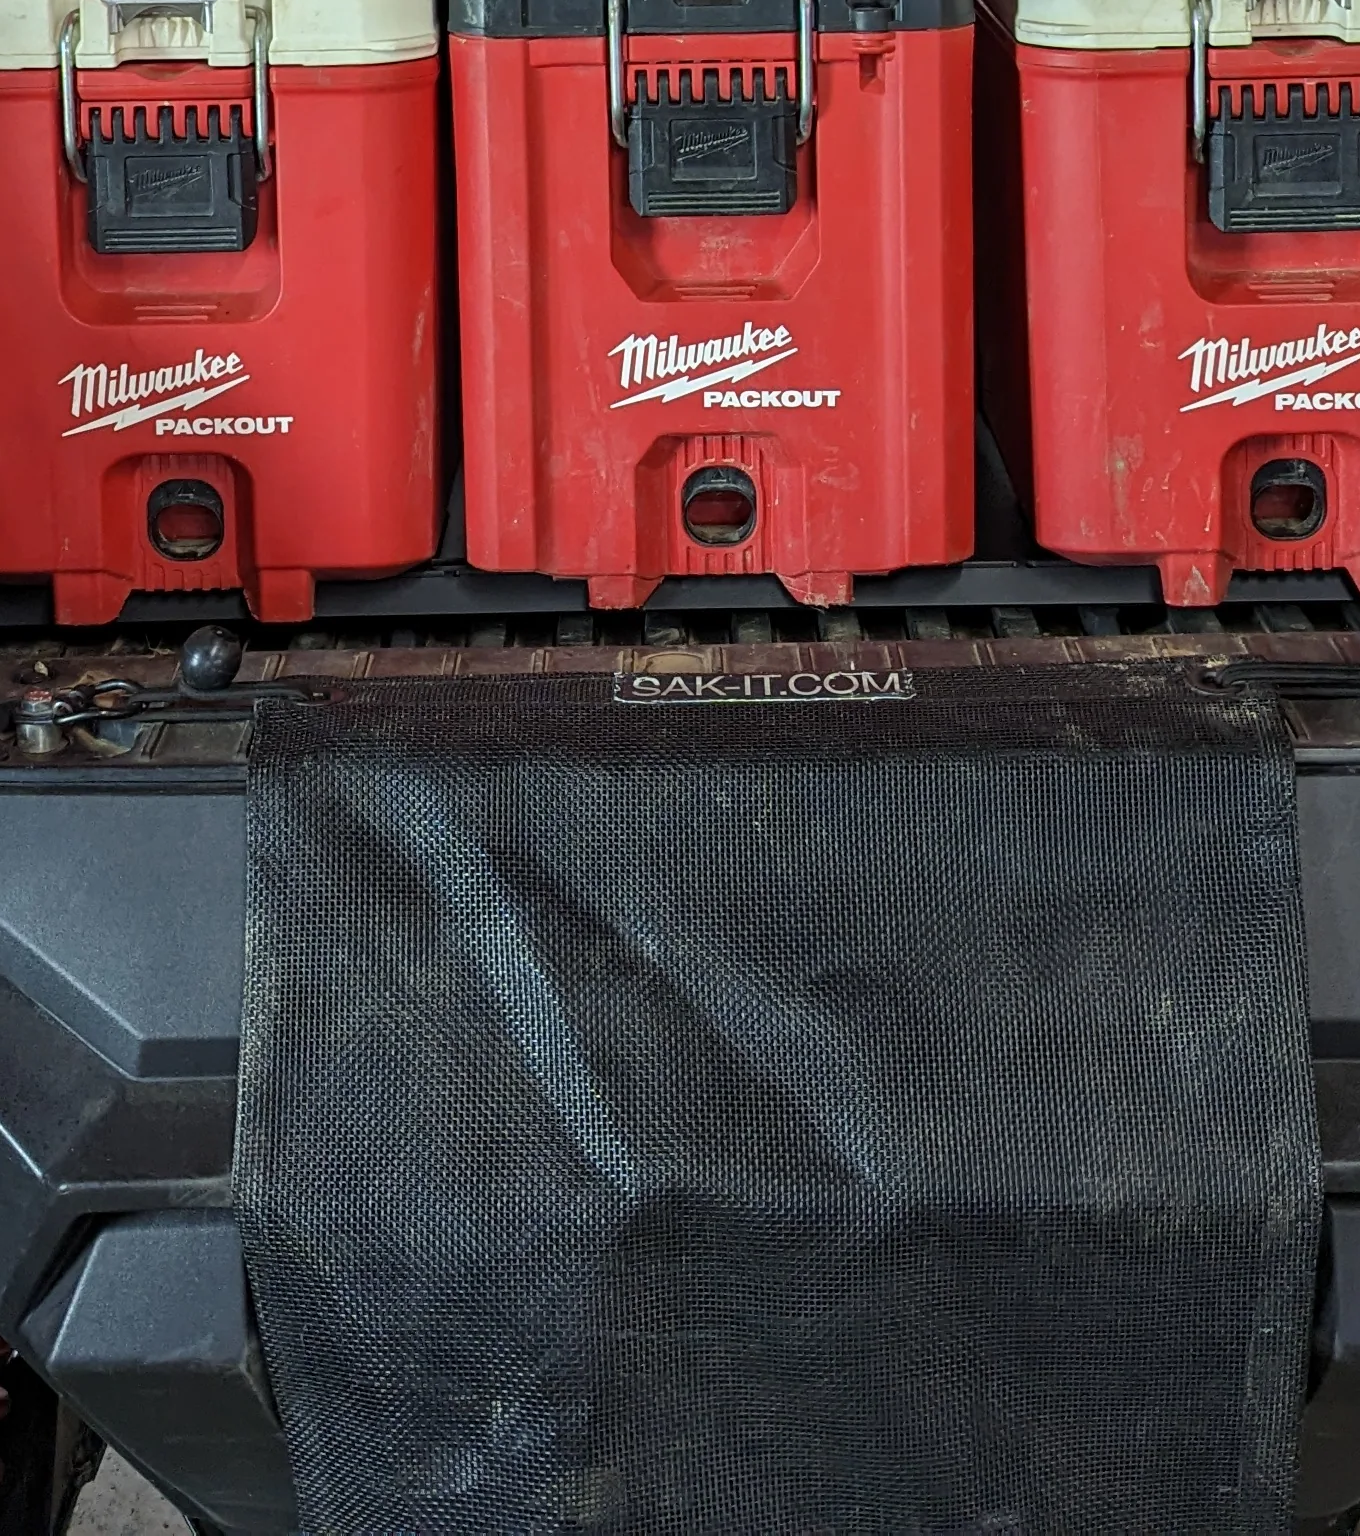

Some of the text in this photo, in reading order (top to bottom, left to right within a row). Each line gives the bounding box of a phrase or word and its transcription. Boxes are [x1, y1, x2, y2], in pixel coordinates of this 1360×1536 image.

[607, 321, 793, 390] Milwaukee
[57, 349, 244, 418] Milwaukee
[703, 390, 841, 408] PACKOUT
[155, 416, 294, 436] PACKOUT
[630, 671, 903, 698] SAK-IT.COM
